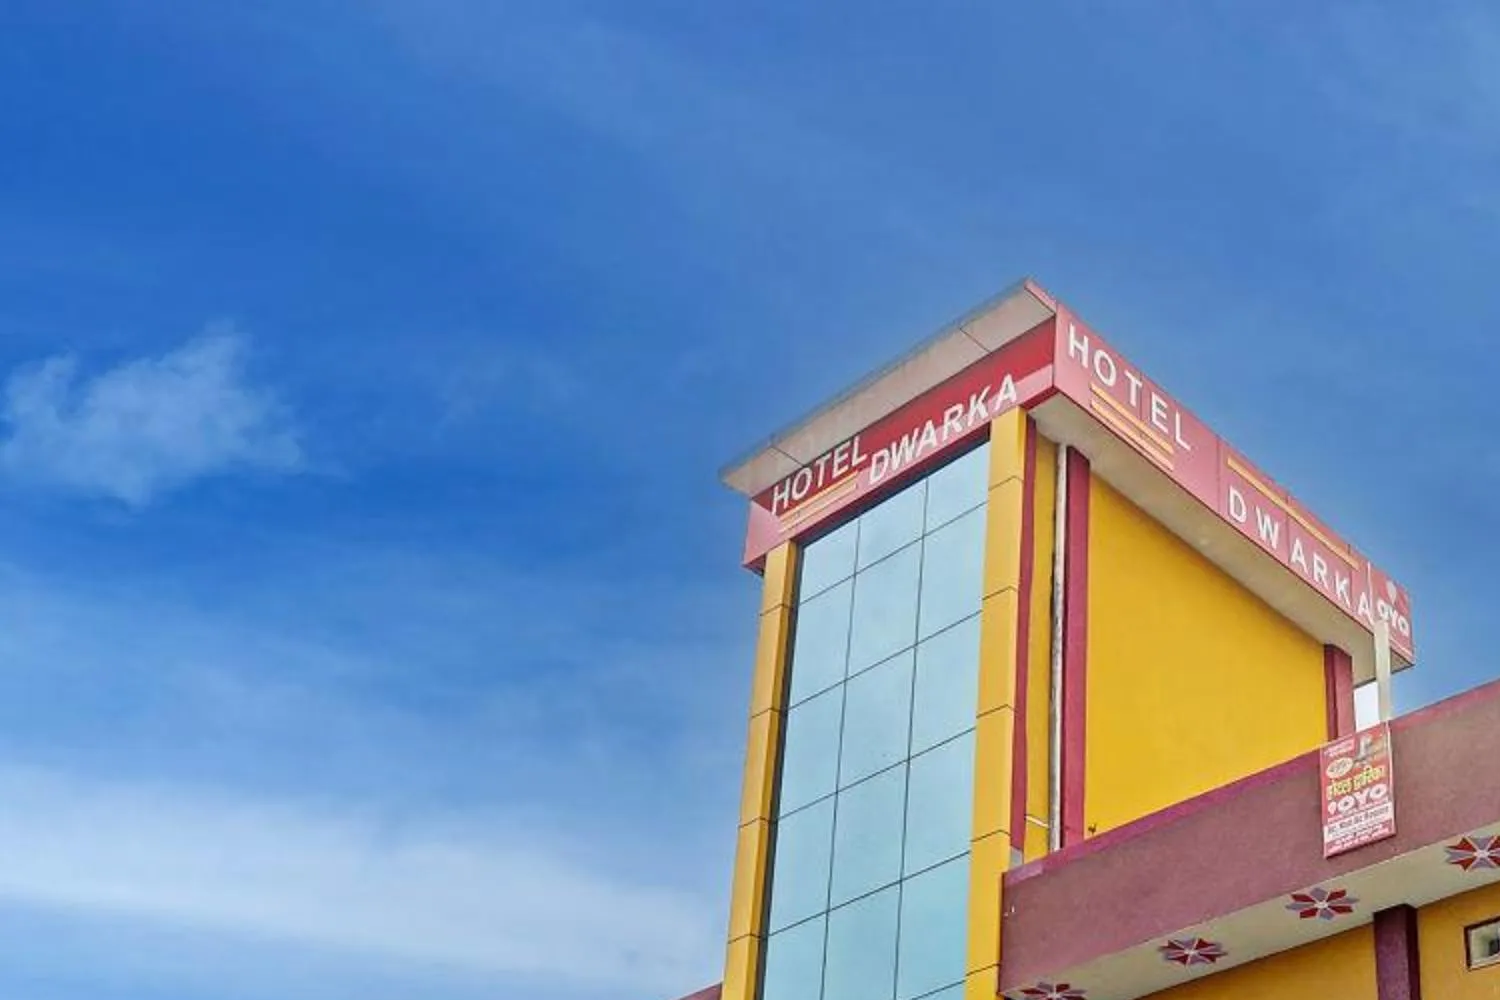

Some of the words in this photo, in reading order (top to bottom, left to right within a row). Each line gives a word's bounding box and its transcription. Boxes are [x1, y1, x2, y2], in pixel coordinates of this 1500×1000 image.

[771, 434, 868, 516] HOTEL
[868, 373, 1018, 485] DWARKA
[1067, 321, 1192, 452] HOTEL
[1228, 485, 1375, 627] DWARKA
[1337, 783, 1388, 814] OYO
